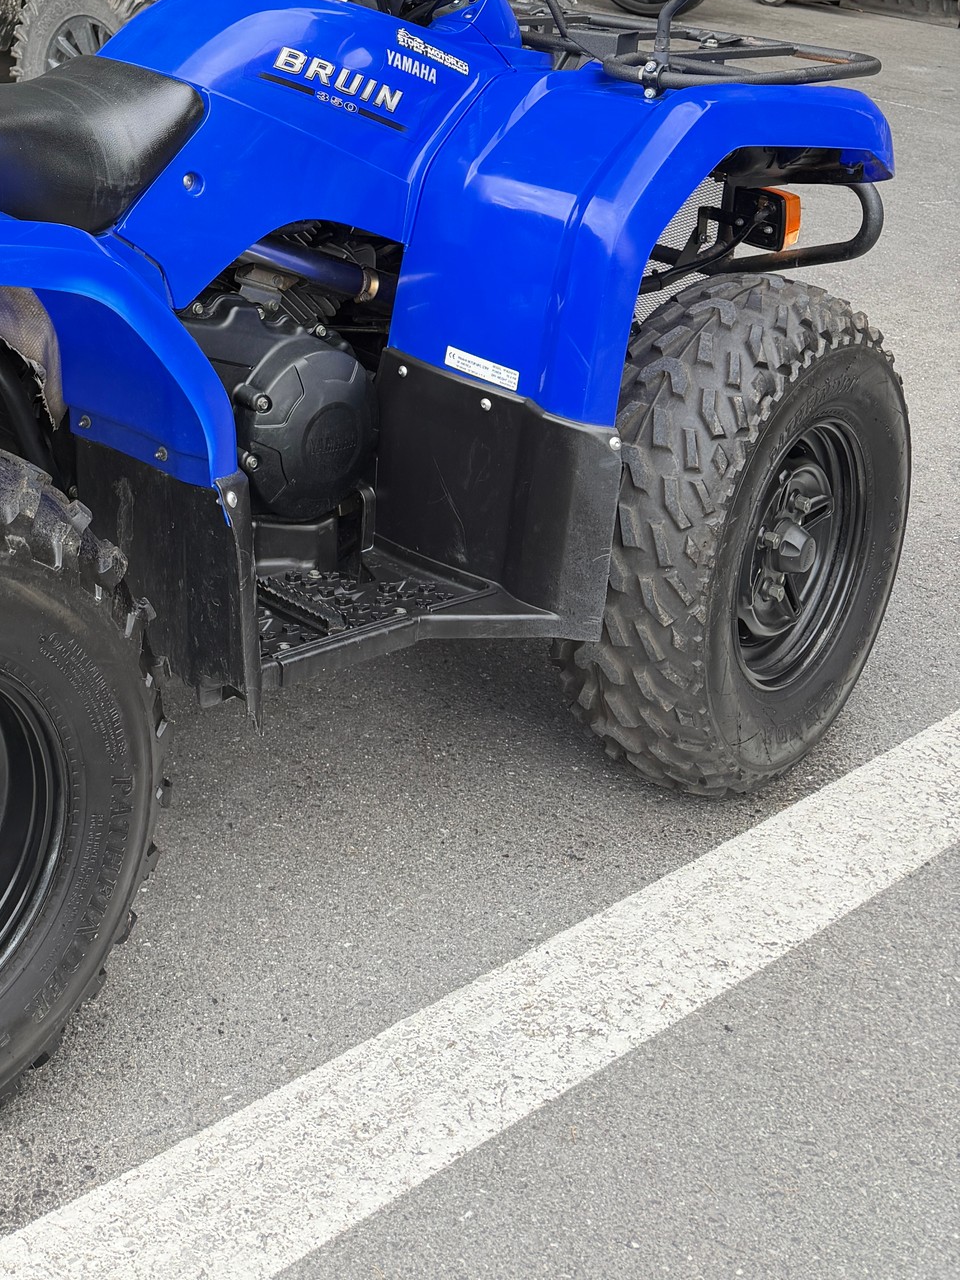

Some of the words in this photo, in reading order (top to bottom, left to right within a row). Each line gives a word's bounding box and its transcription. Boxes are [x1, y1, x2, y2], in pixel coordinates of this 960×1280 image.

[273, 46, 404, 113] BRUIN
[386, 48, 437, 85] YAMAHA
[316, 91, 359, 113] 350
[26, 773, 136, 1024] PATHFINDER
